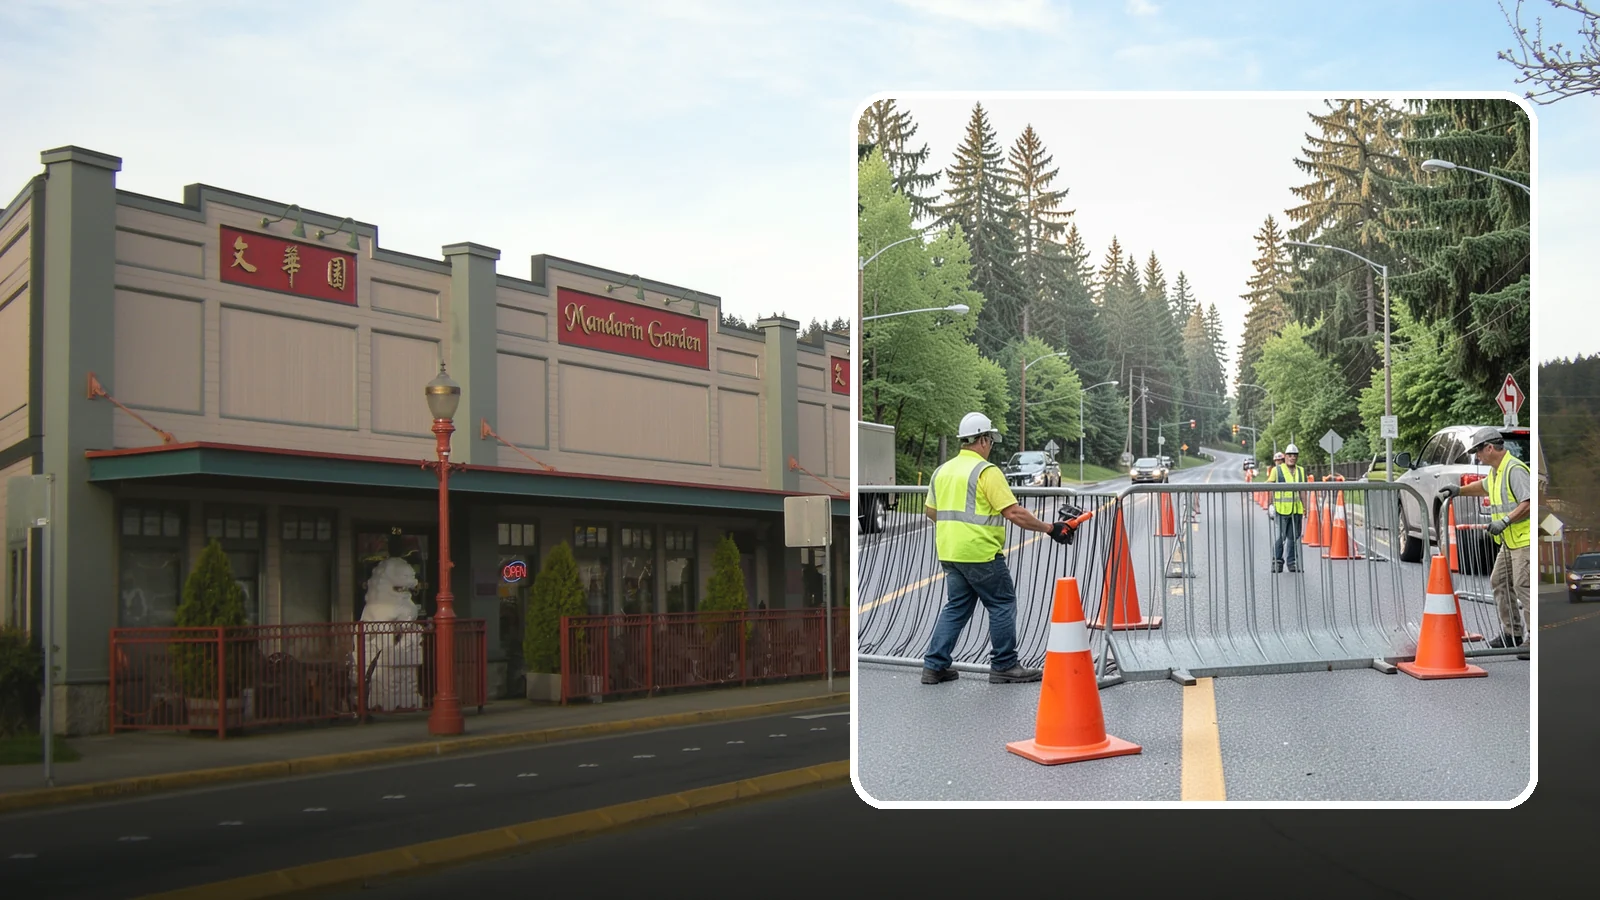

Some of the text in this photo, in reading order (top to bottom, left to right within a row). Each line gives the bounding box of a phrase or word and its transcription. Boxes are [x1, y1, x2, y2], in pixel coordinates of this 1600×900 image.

[231, 235, 346, 290] 文華園
[564, 302, 702, 352] Mandarin Garden
[503, 565, 527, 578] OPEN
